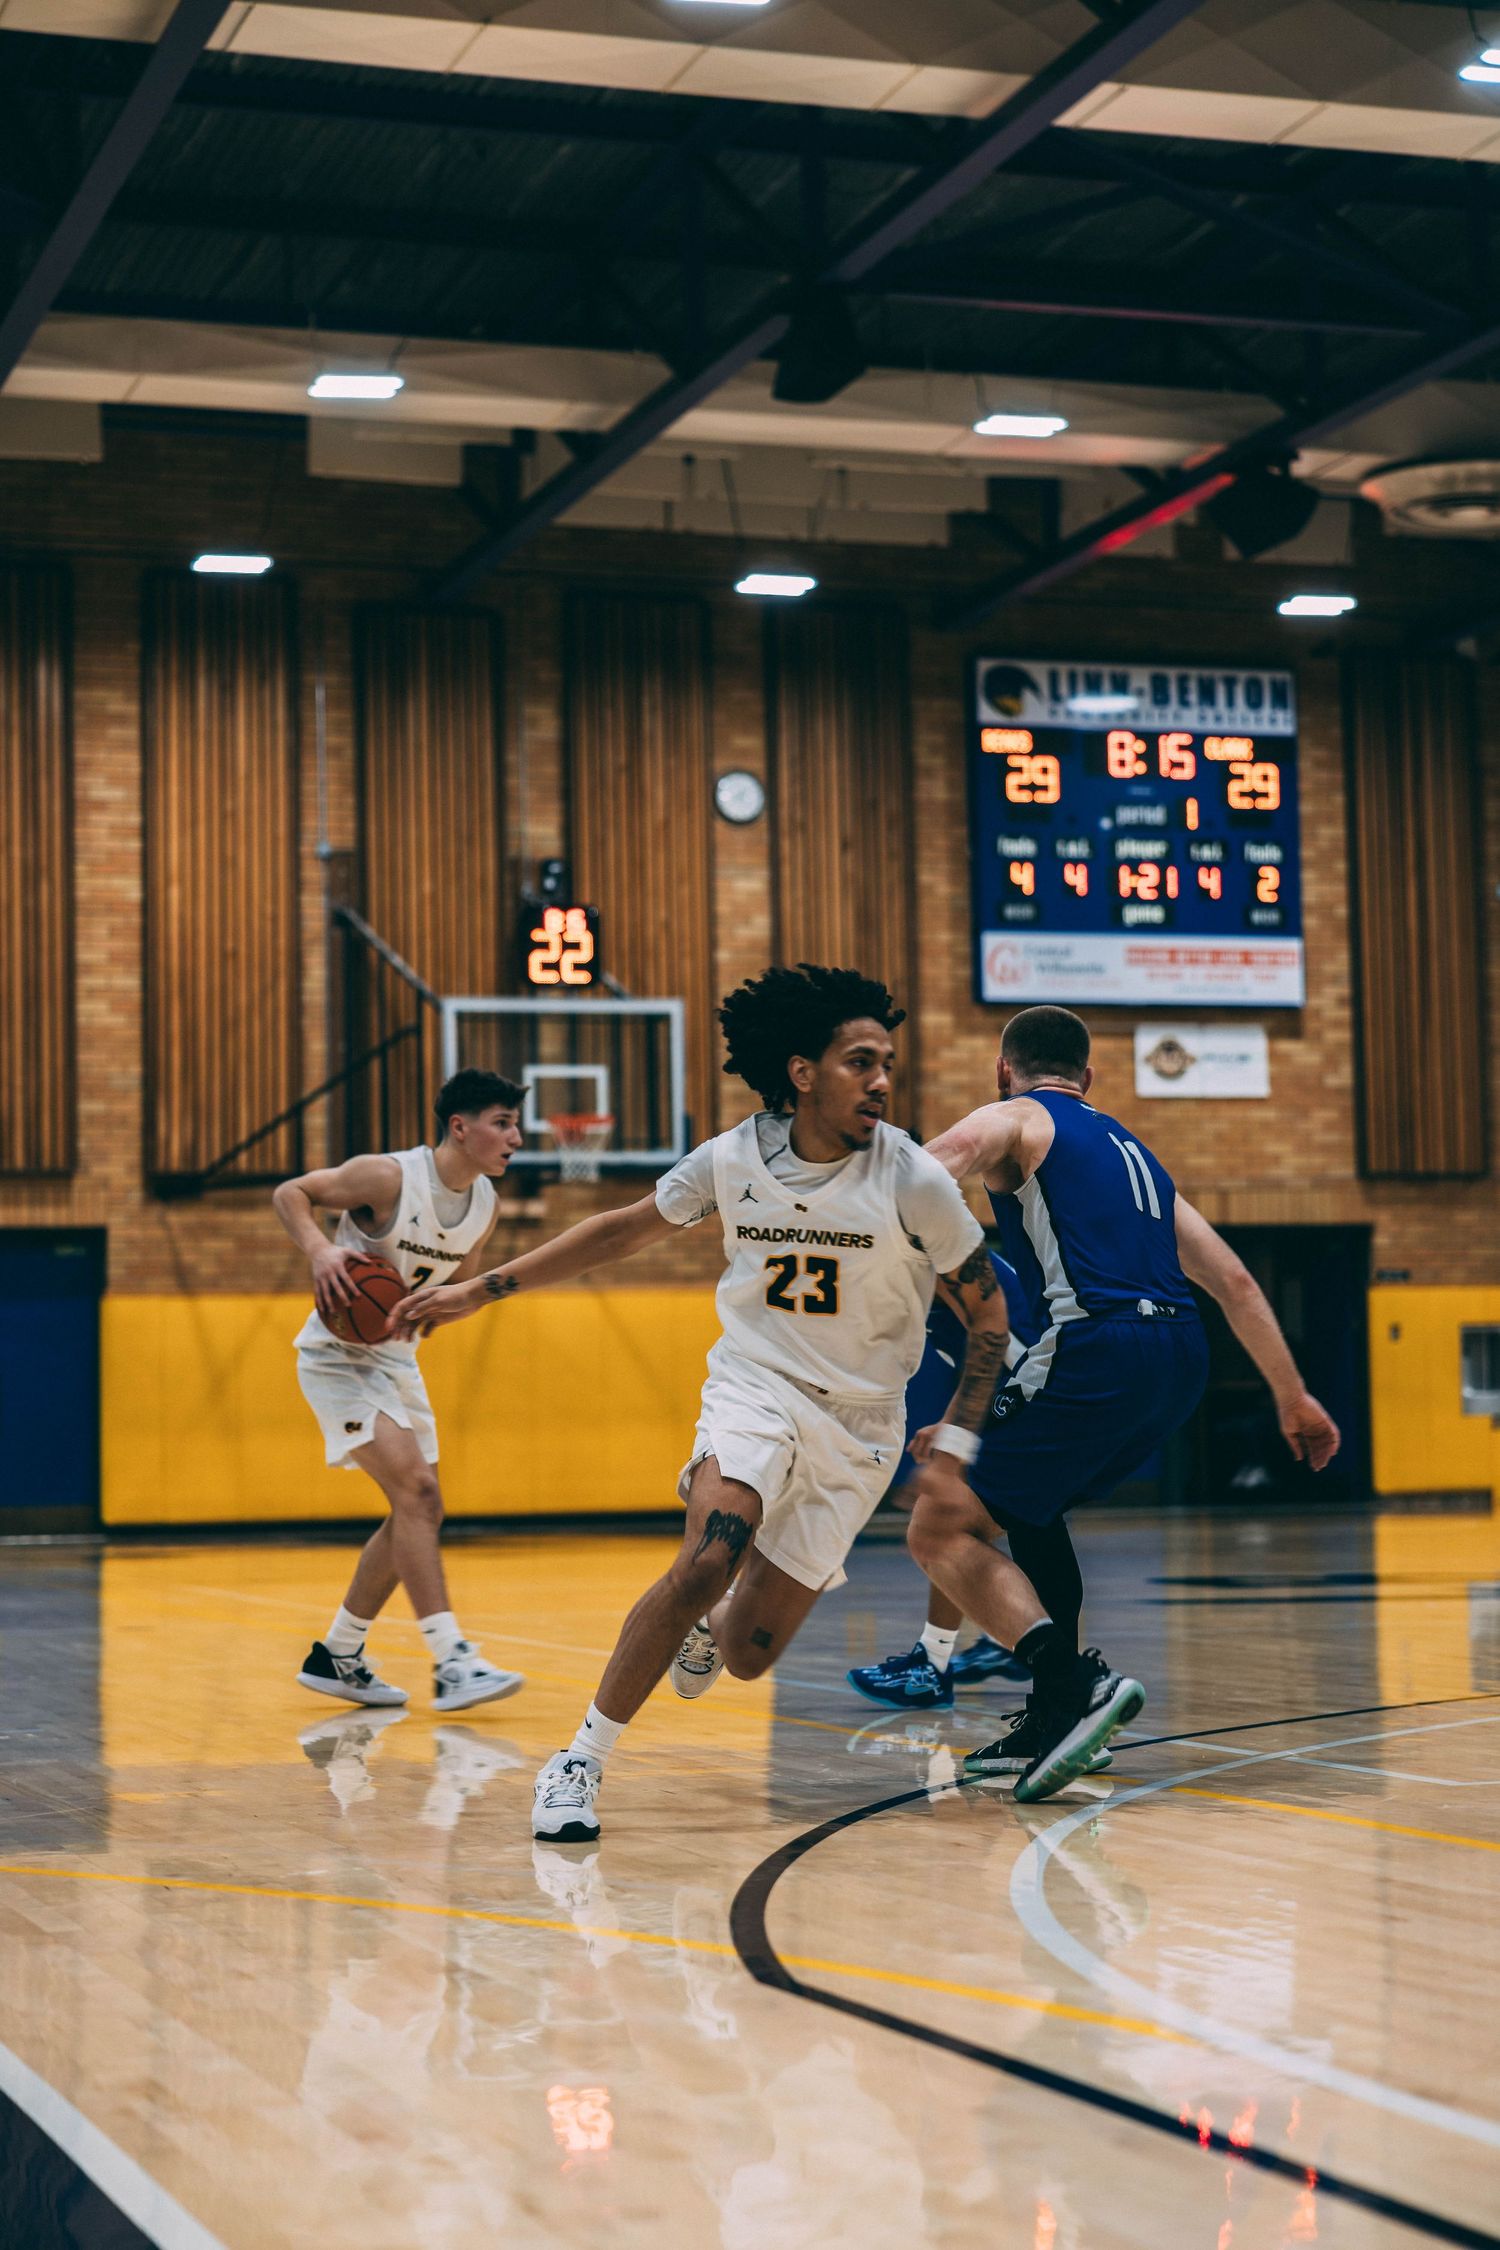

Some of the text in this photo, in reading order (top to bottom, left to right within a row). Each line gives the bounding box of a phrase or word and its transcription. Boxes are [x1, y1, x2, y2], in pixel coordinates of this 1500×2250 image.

[1005, 755, 1061, 804] 29
[1227, 762, 1280, 811] 29
[1009, 861, 1035, 896] 4
[1063, 862, 1088, 897] 4
[1197, 866, 1222, 900] 4
[1256, 865, 1280, 904] 2
[527, 928, 594, 985] 22
[1107, 1131, 1161, 1220] 11
[736, 1225, 874, 1249] ROADRUNNERS
[765, 1251, 850, 1316] 23
